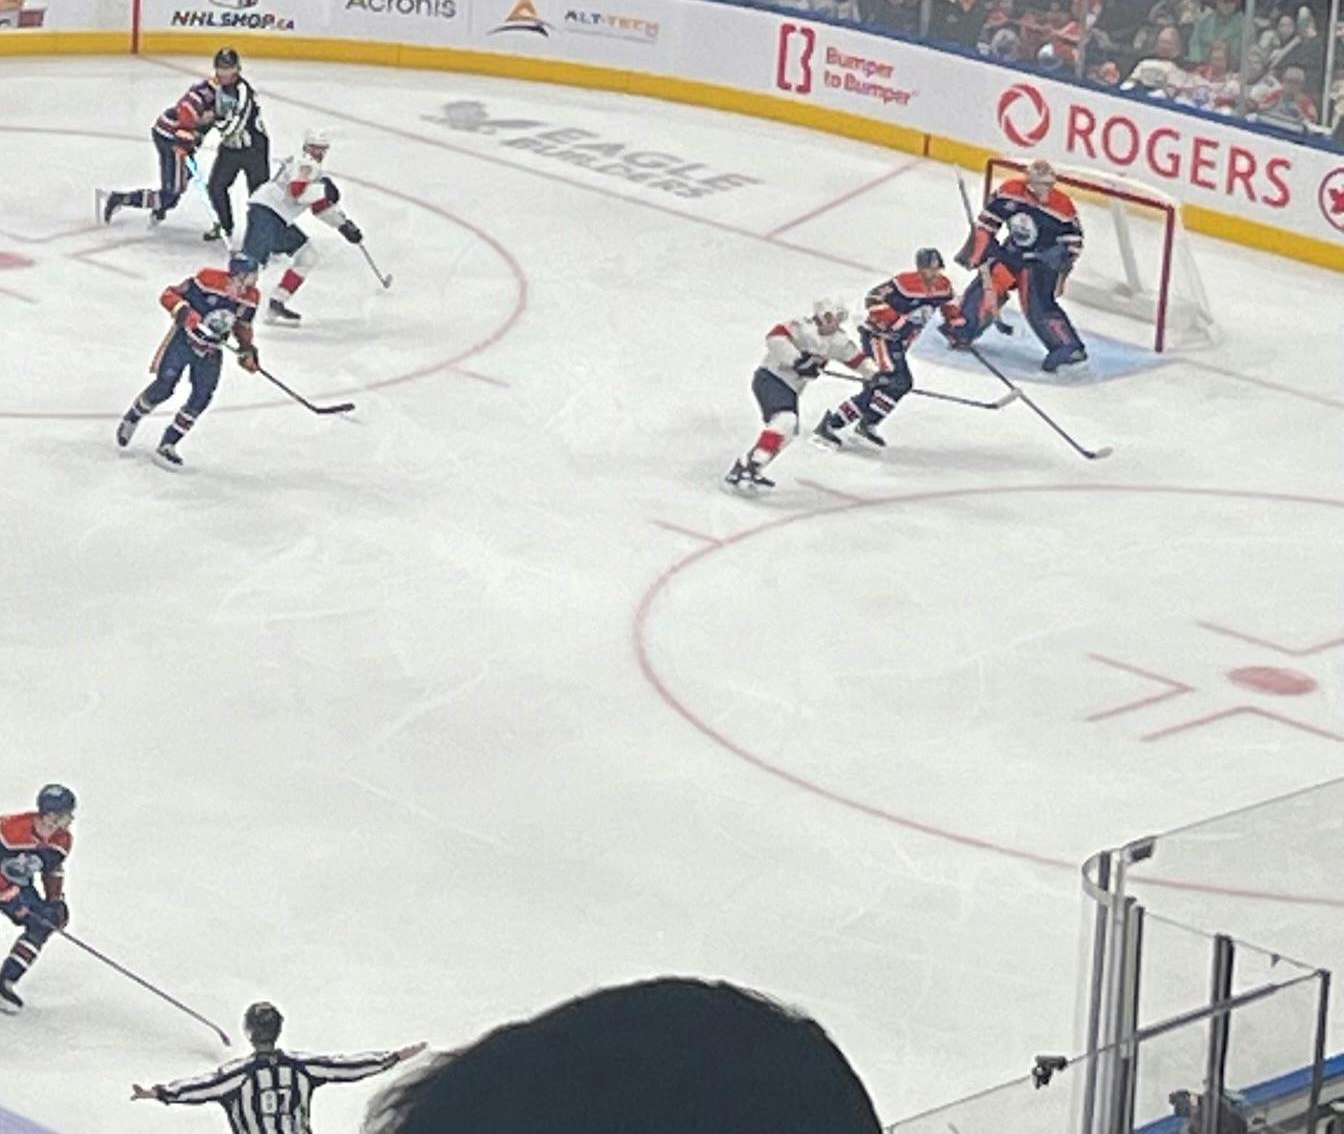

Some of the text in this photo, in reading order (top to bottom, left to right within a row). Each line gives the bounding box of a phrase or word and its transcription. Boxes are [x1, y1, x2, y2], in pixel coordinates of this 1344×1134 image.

[826, 46, 894, 78] Bumper
[824, 69, 911, 105] to Bumper
[1066, 104, 1292, 208] ROGERS
